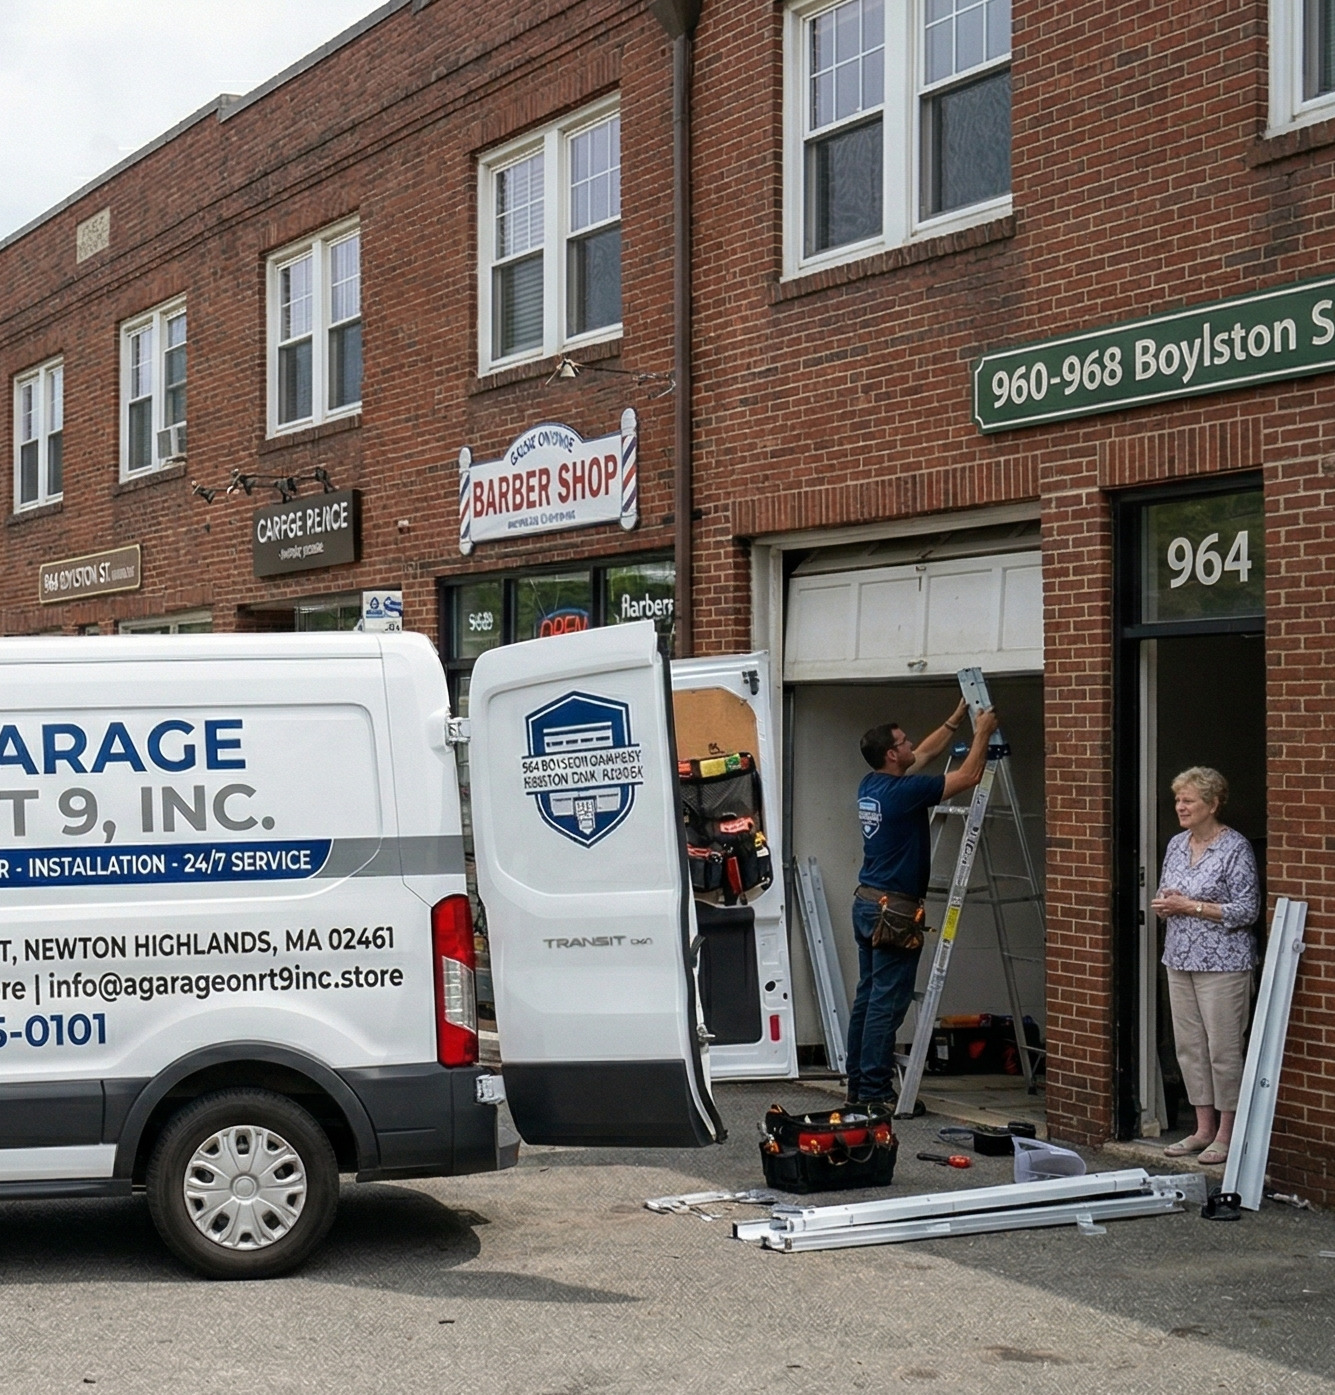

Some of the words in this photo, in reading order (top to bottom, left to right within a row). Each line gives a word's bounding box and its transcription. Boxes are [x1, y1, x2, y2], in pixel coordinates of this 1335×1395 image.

[992, 346, 1123, 409] 960-968
[1135, 317, 1297, 384] Boylston
[473, 467, 551, 518] BARBER
[558, 454, 618, 504] SHOP
[1167, 530, 1252, 589] 964
[58, 787, 116, 844] 9,
[140, 783, 275, 833] INC.
[28, 854, 165, 877] INSTALLATION
[183, 849, 226, 874] 24/7
[231, 850, 312, 871] SERVICE
[24, 936, 126, 961] NEWTON
[134, 930, 278, 957] HIGHLANDS,
[285, 928, 322, 952] MA
[328, 926, 394, 950] 02461
[543, 935, 627, 949] TRANSIT
[49, 964, 404, 1002] info@agarageonrt9inc.store
